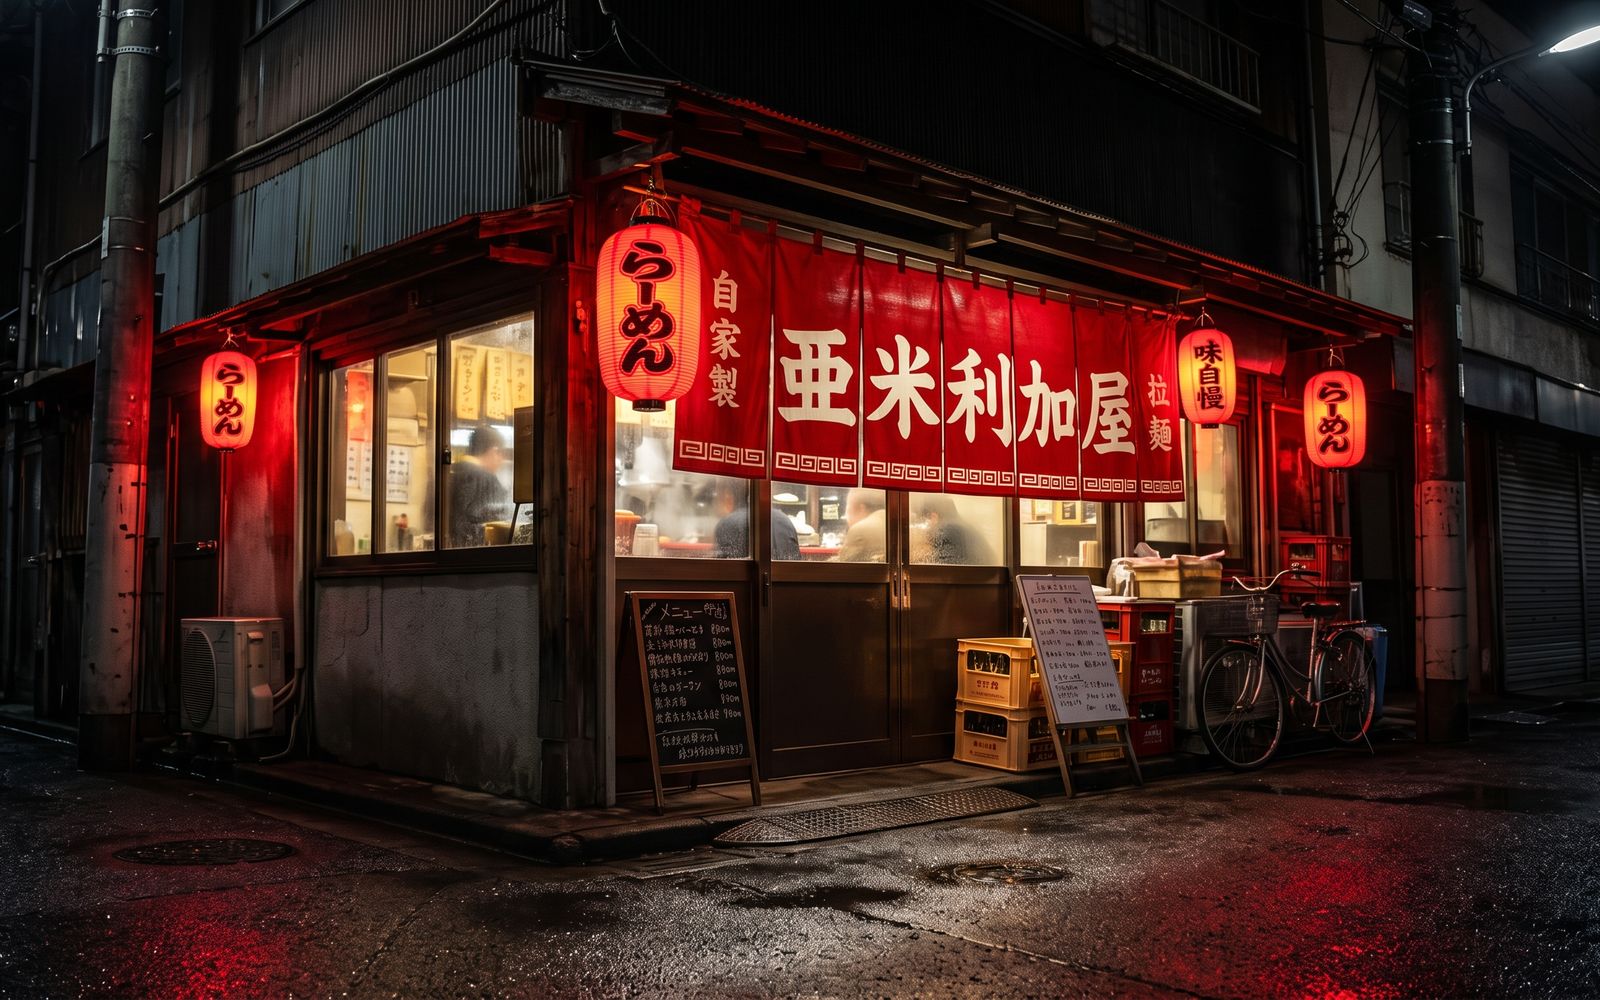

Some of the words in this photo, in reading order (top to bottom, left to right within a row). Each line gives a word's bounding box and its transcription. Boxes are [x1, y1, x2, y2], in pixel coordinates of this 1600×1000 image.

[620, 241, 676, 376] らーめん
[708, 270, 742, 409] 自家製
[213, 362, 245, 436] らーめん
[778, 328, 1136, 455] 亜米利加屋
[1147, 373, 1173, 452] 拉麺
[1193, 340, 1225, 410] 味自慢
[1317, 381, 1350, 455] らーめん
